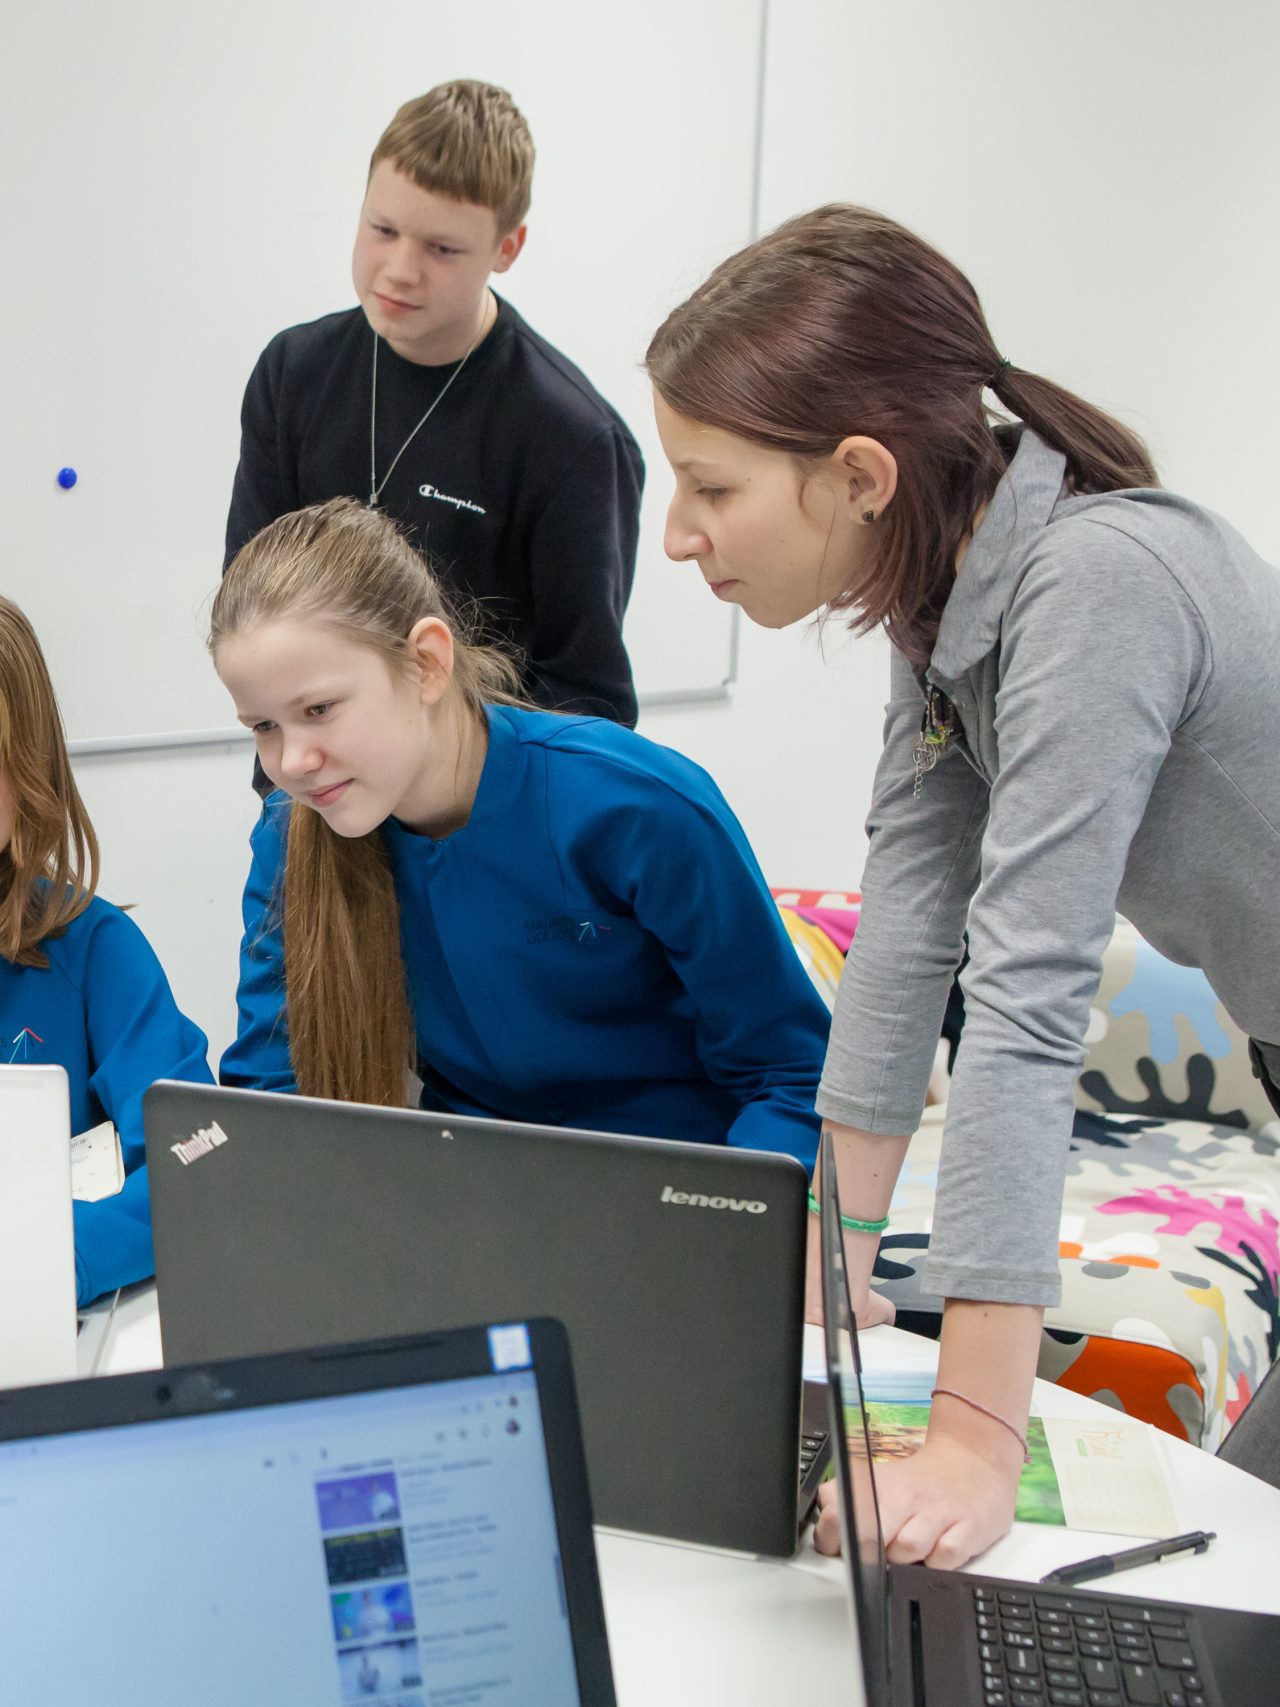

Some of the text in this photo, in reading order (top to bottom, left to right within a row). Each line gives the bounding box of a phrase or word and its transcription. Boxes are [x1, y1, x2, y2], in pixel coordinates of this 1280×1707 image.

[419, 484, 486, 514] Champion
[170, 1120, 228, 1166] ThinkPad
[661, 1186, 768, 1214] lenovo
